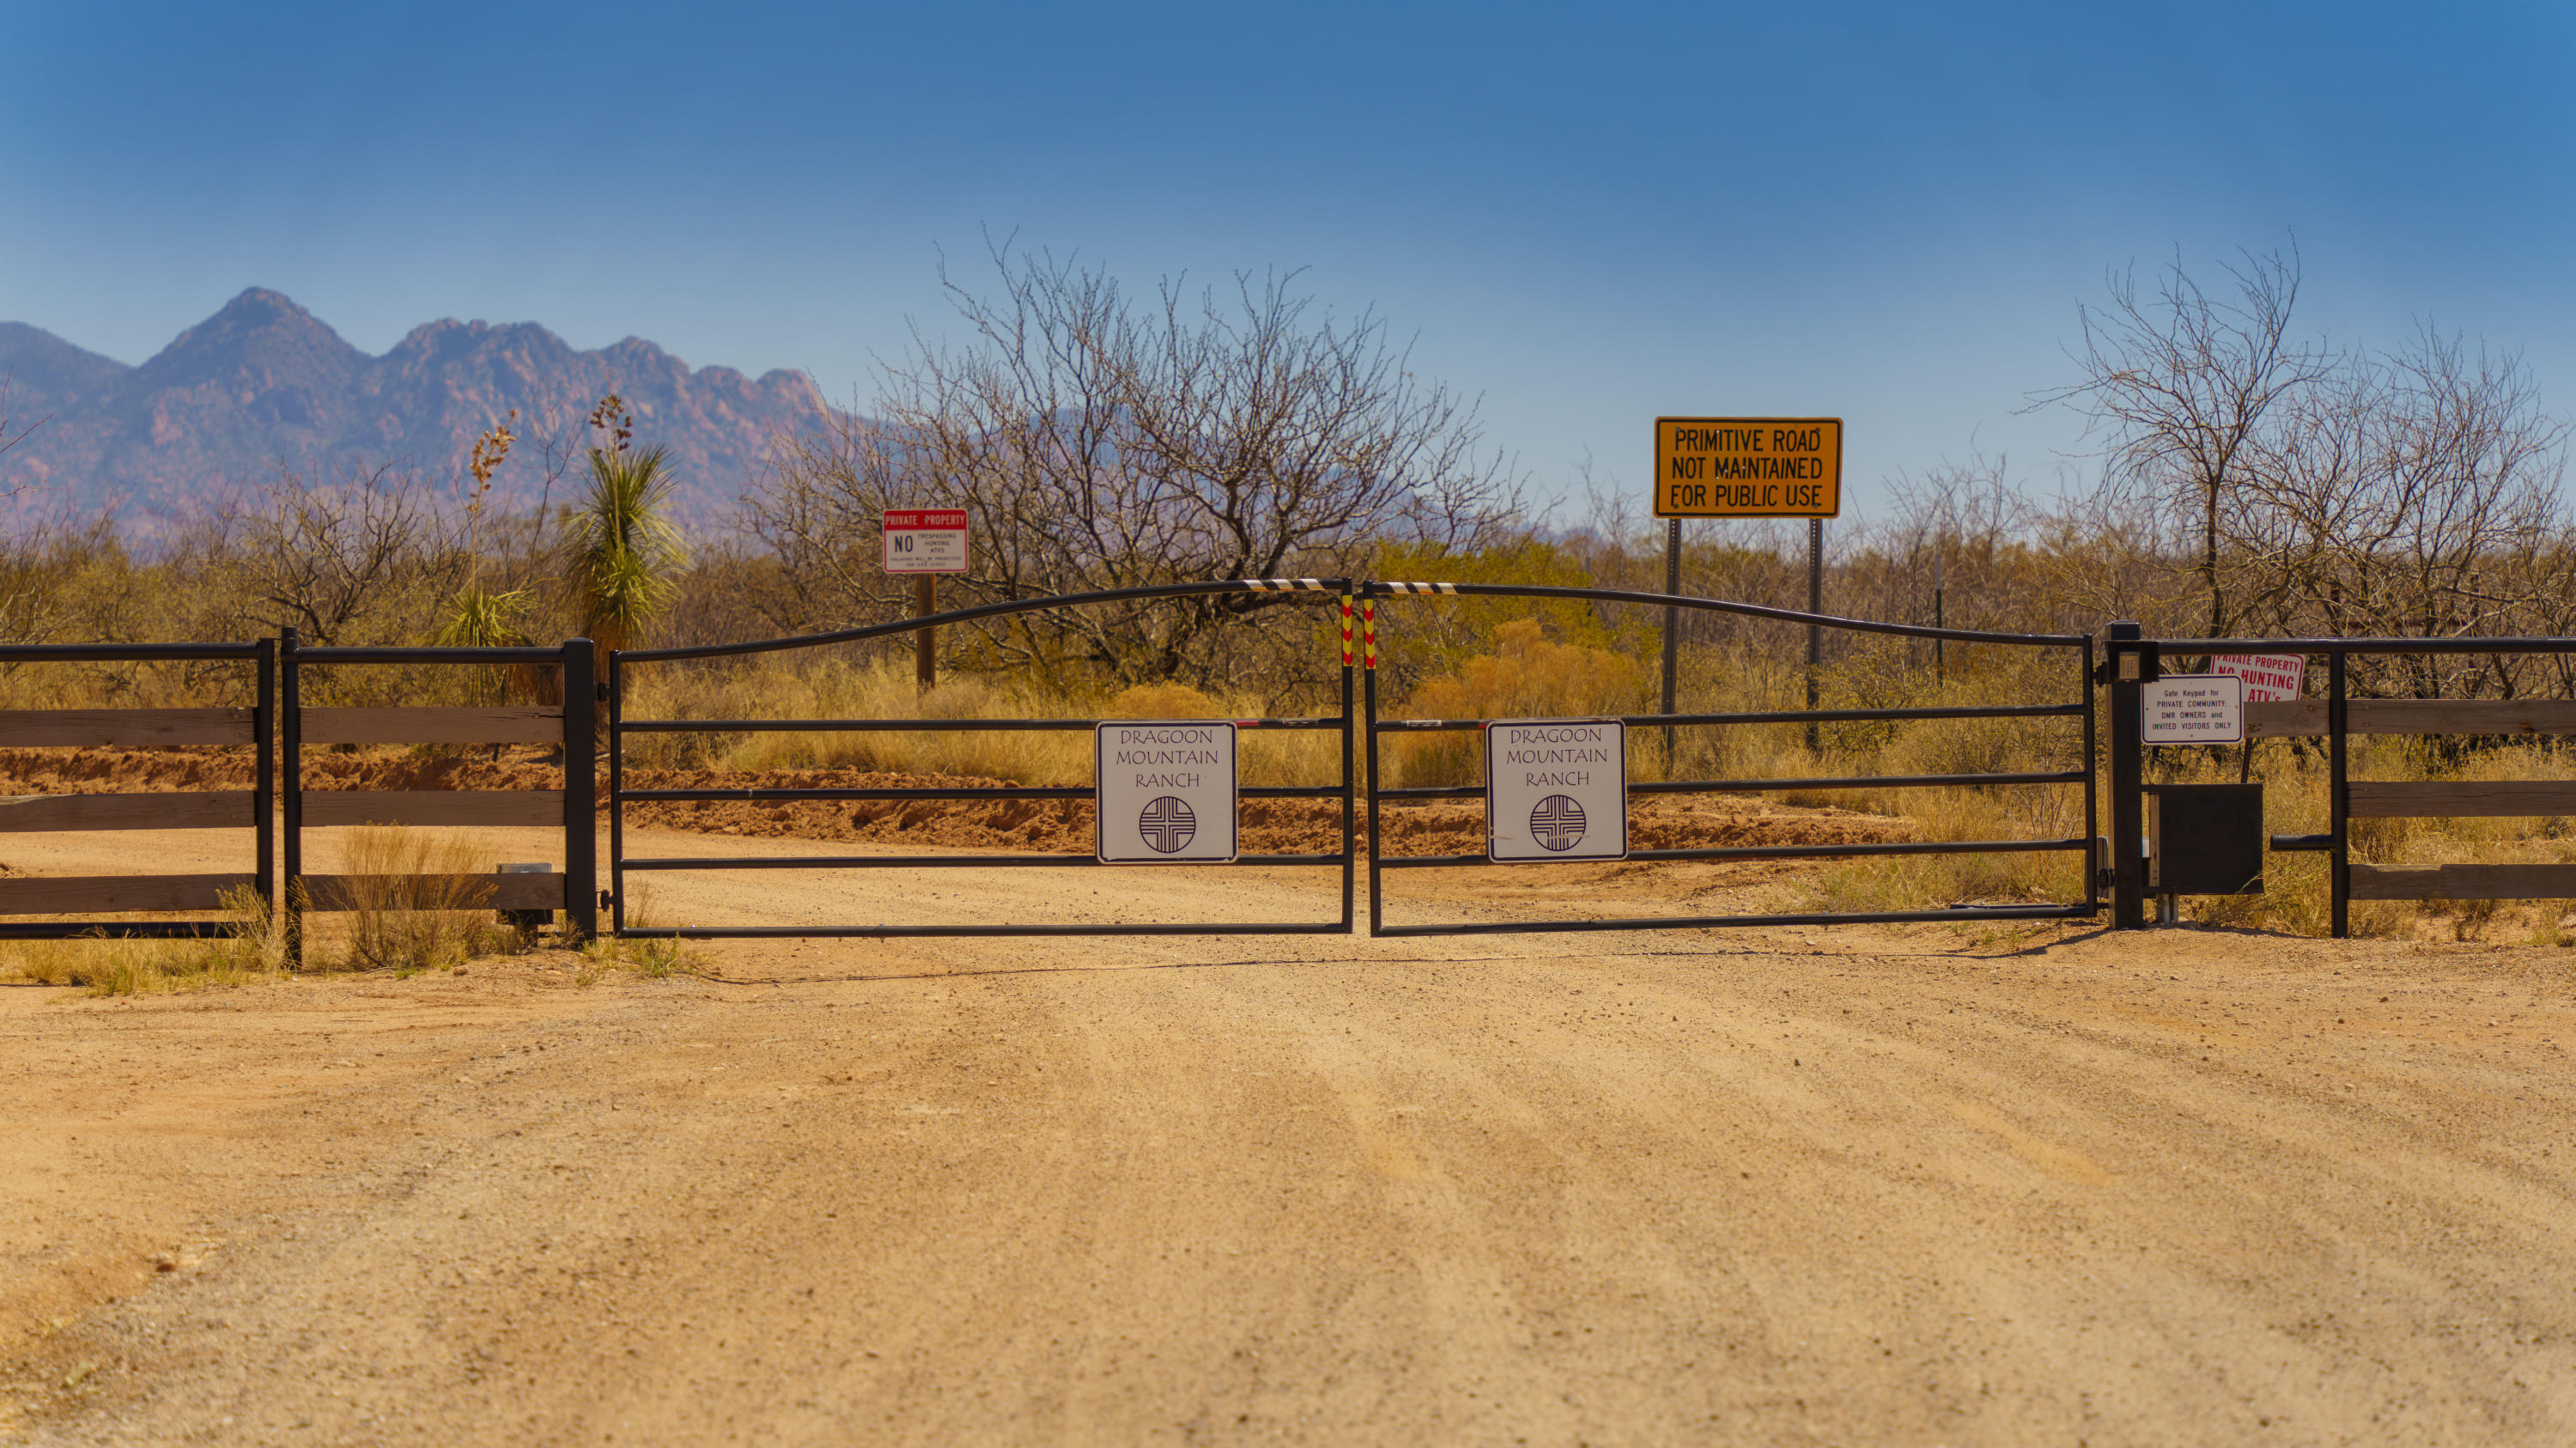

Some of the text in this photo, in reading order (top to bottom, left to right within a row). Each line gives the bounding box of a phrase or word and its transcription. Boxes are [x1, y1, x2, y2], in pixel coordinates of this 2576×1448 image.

[1675, 429, 1820, 452] PRIMITIVE ROAD
[1672, 457, 1822, 479] NOT MAINTAINED
[1671, 484, 1822, 507] FOR PUBLIC USE
[885, 514, 965, 526] PRIVATE PROPERTY
[895, 535, 914, 552] NO
[2217, 654, 2300, 672] PRIVATE PROPERTY
[2241, 669, 2294, 690] HUNTING
[1121, 730, 1212, 745] DRAGOON
[1510, 728, 1601, 744] DRAGOON
[1116, 750, 1218, 765] MOUNTAIN
[1506, 749, 1607, 764] MOUNTAIN
[1136, 773, 1200, 788] RANCH
[1526, 771, 1589, 787] RANCH
